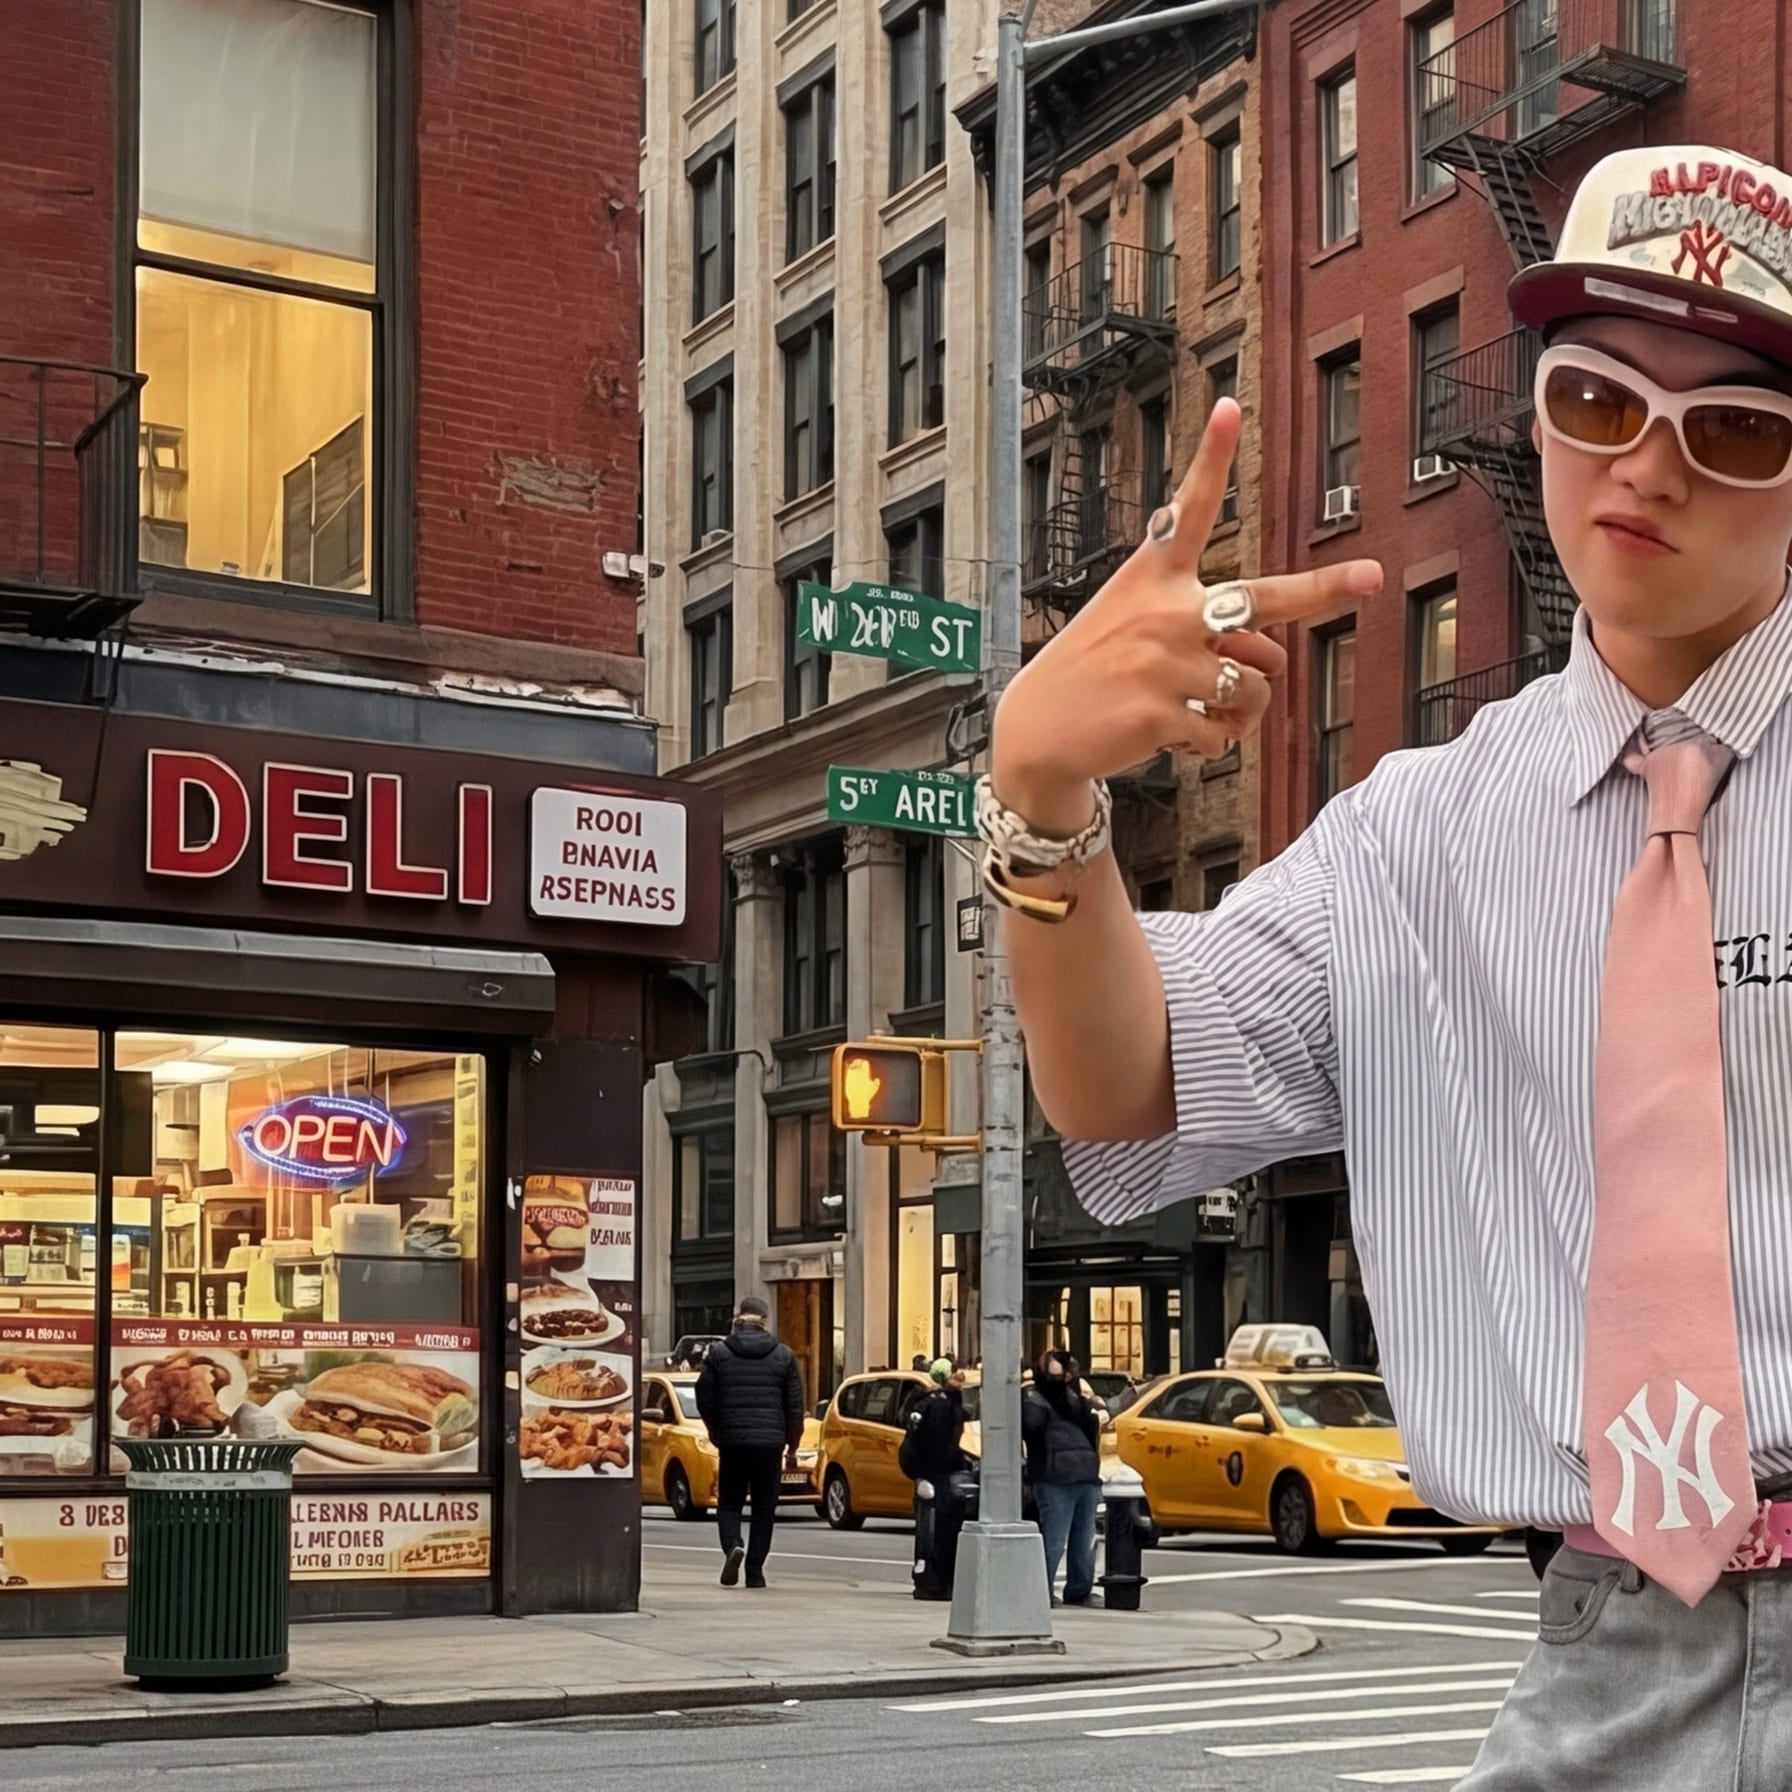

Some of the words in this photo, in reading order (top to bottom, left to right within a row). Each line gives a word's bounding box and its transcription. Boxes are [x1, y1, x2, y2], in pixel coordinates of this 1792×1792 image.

[930, 615, 974, 660] ST
[146, 748, 493, 905] DELI
[253, 1114, 394, 1166] OPEN
[1603, 1379, 1735, 1537] NY
